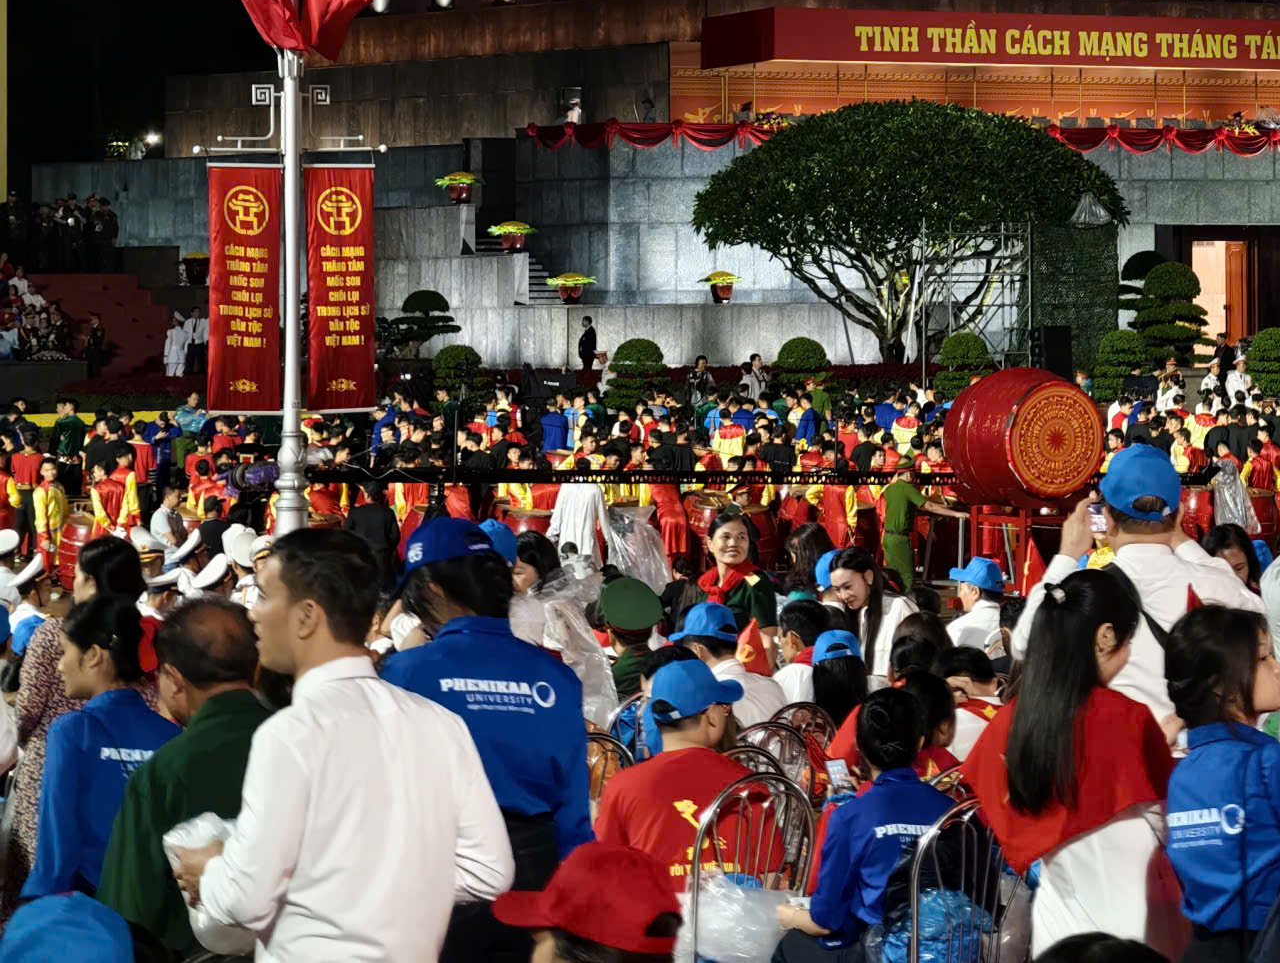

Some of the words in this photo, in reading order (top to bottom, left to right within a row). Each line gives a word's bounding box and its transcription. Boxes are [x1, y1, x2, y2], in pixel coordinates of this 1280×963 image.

[854, 25, 920, 53] TINH
[926, 19, 998, 54] THẦN
[1005, 23, 1071, 56] CÁCH
[1078, 30, 1149, 62] MẠNG
[1155, 28, 1238, 60] THÁNG
[439, 677, 533, 696] PHENIKAA
[465, 693, 534, 706] UNIVERSITY
